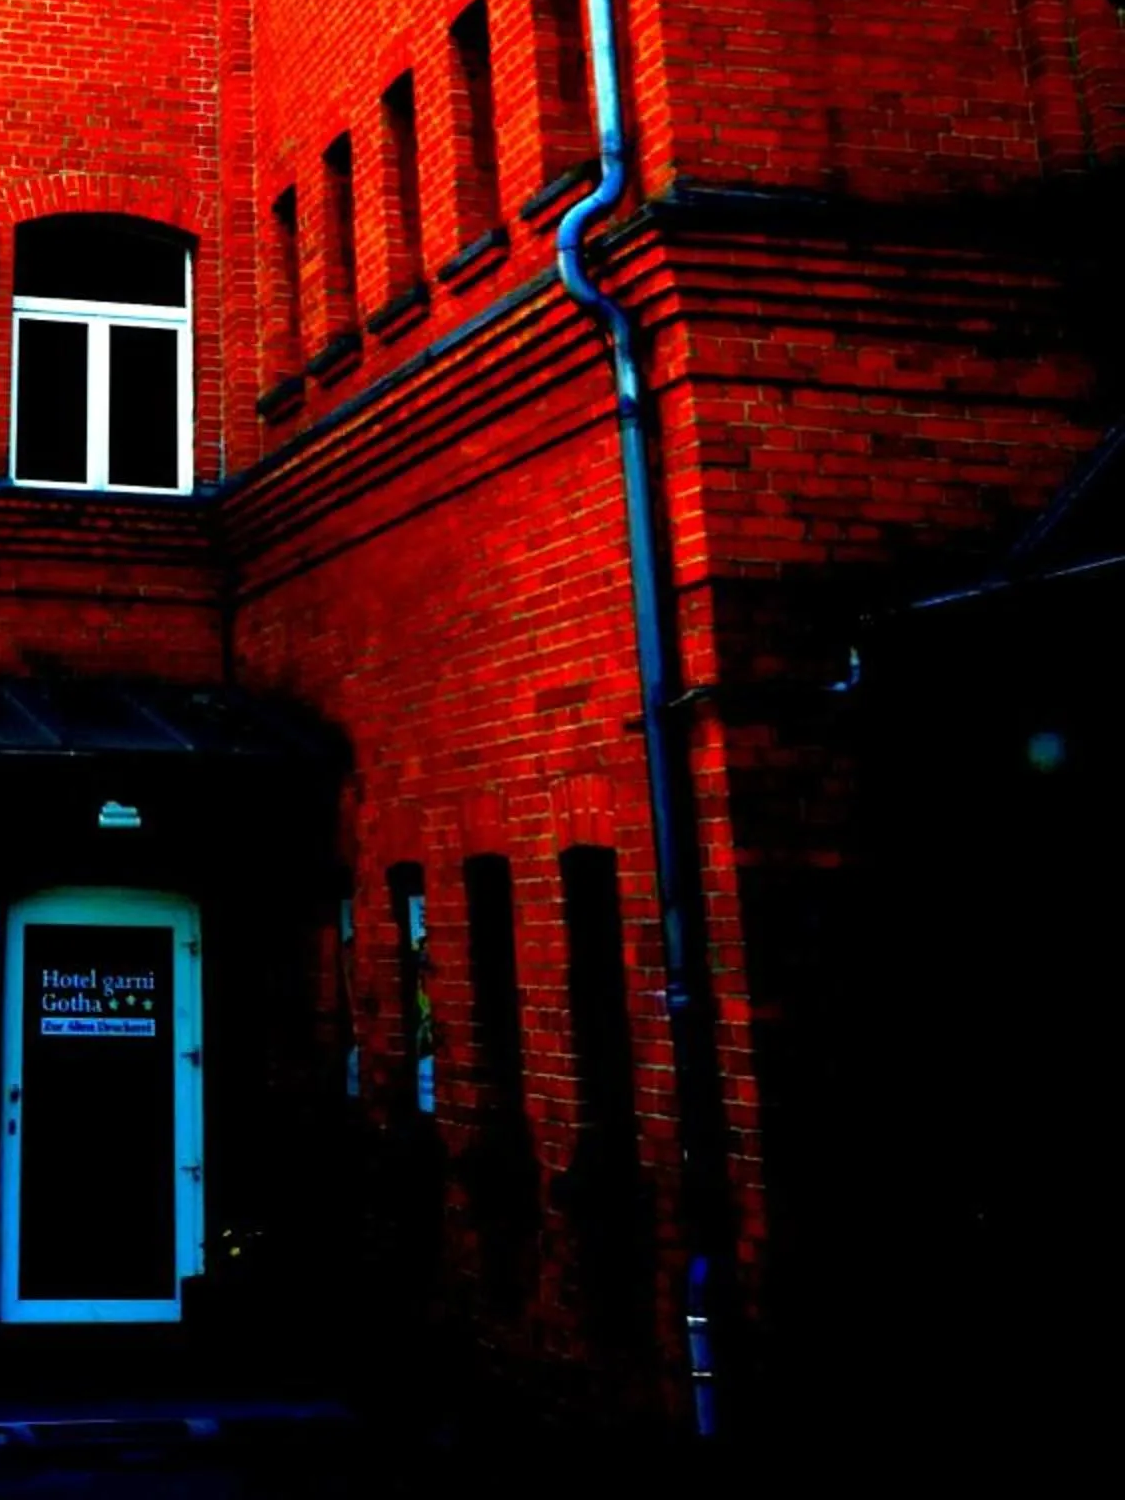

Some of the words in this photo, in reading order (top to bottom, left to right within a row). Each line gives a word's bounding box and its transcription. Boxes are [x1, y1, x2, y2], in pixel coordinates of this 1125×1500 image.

[42, 969, 97, 989] Hotel
[102, 971, 156, 997] garni
[42, 991, 103, 1013] Gotha
